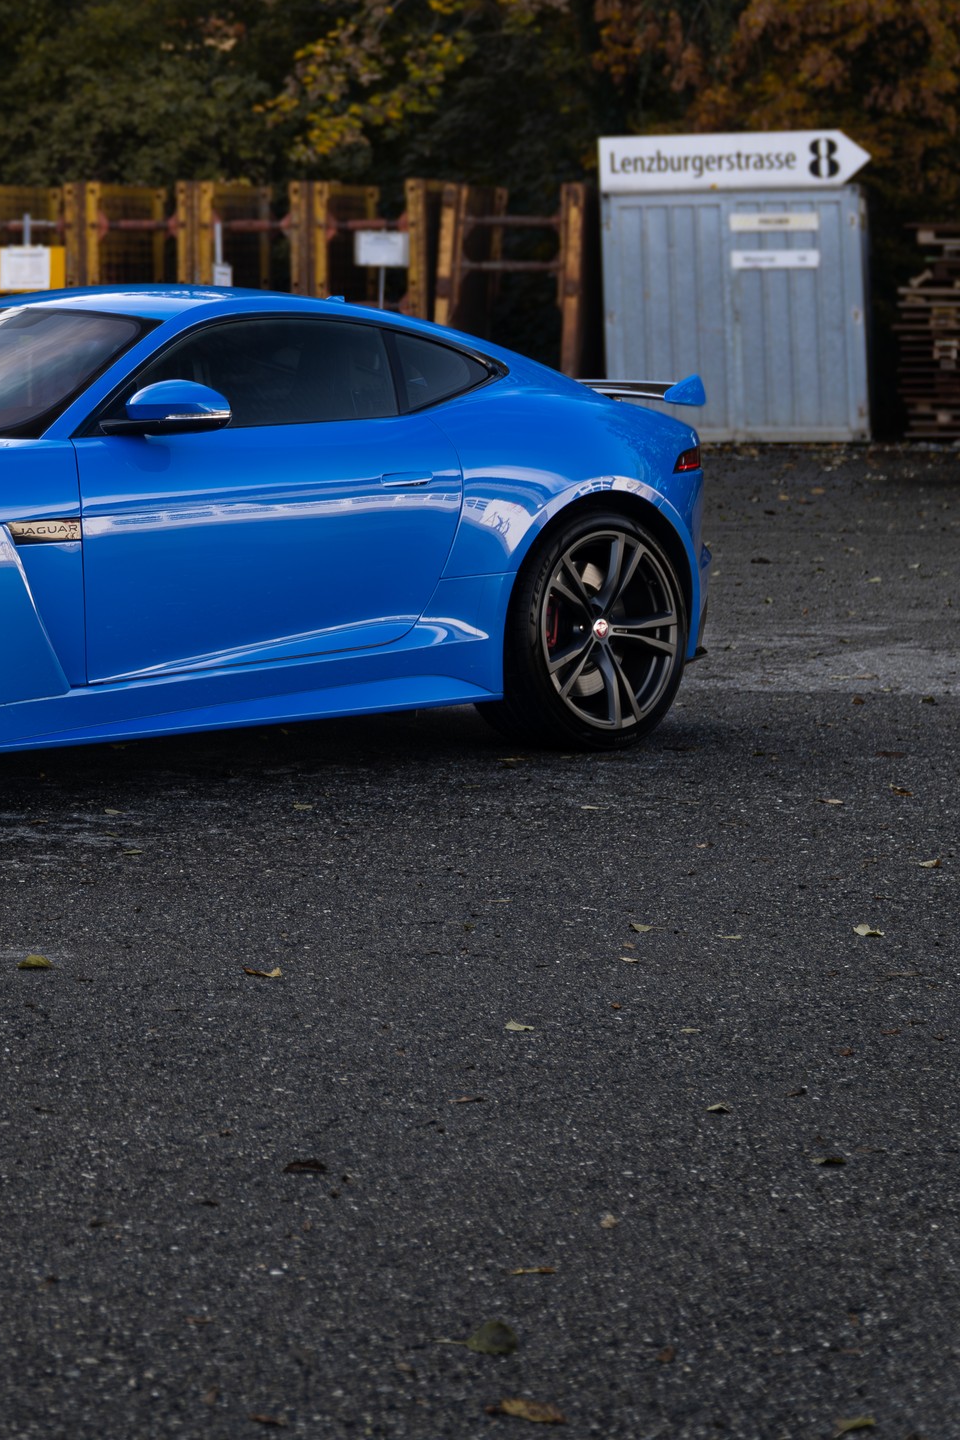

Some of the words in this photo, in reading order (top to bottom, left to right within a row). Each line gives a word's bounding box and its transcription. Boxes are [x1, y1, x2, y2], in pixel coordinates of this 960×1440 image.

[610, 150, 797, 178] Lenzburgerstrasse
[808, 138, 841, 179] 8
[21, 524, 78, 536] JAGUAR
